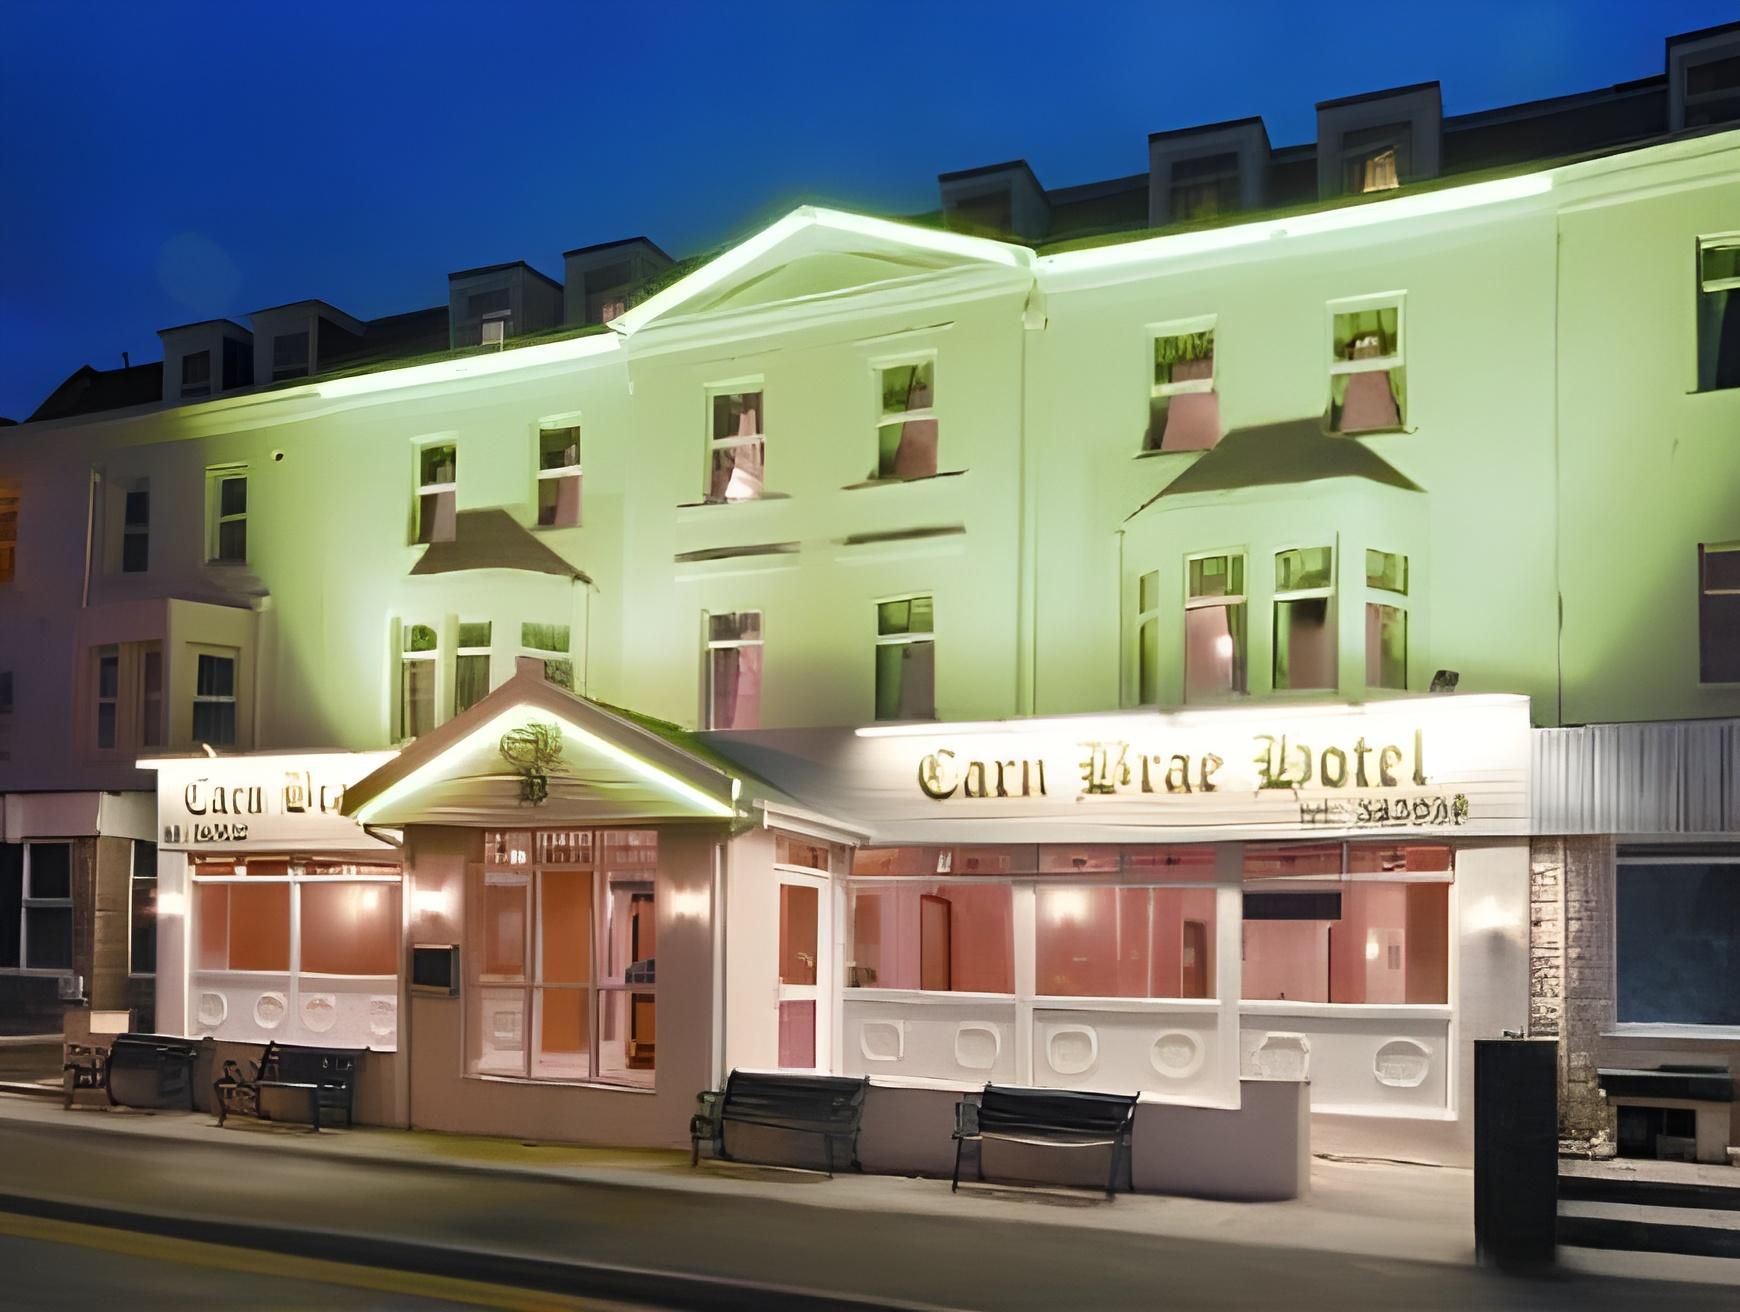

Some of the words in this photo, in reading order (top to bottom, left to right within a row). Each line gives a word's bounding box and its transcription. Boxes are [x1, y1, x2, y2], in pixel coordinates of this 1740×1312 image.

[918, 748, 1047, 800] Carn
[1077, 740, 1224, 796] Brae
[1253, 728, 1429, 795] Hotel
